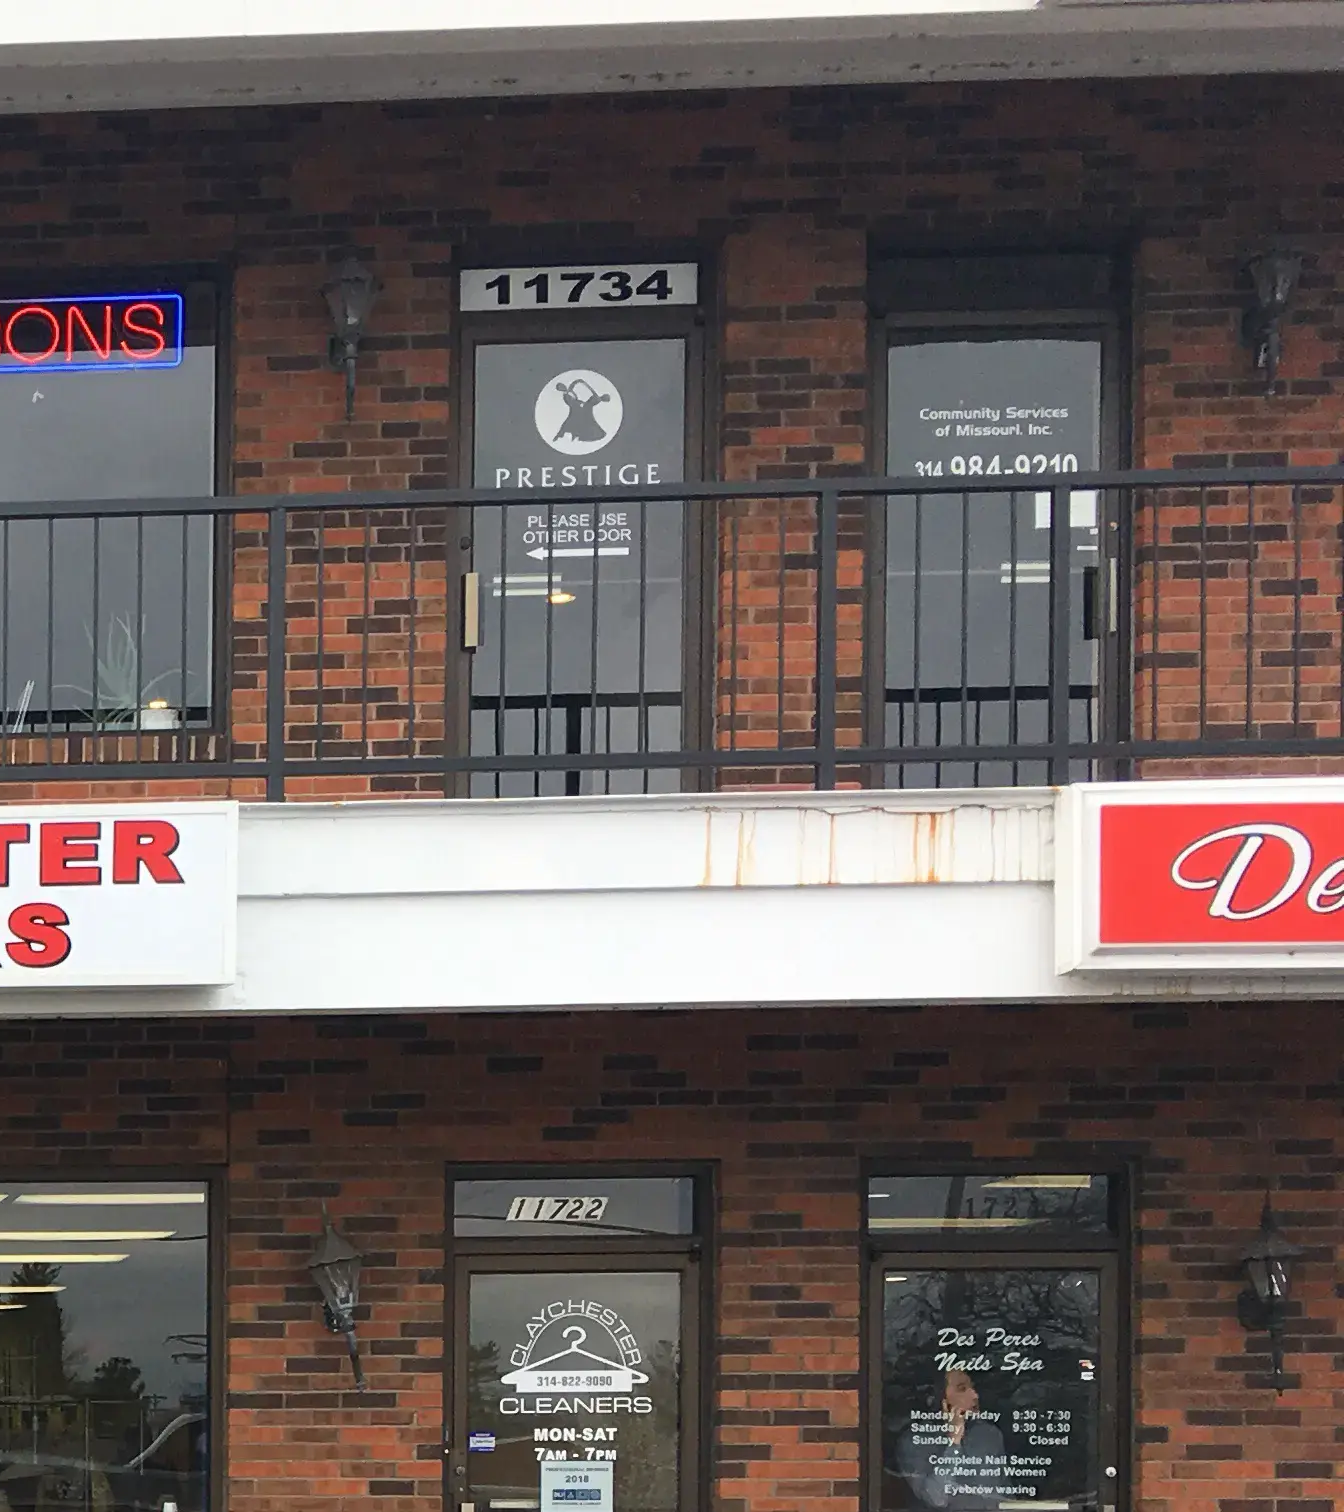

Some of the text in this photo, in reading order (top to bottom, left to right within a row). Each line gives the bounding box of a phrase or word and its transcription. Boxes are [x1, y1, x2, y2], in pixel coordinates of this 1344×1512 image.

[486, 270, 673, 304] 11734
[919, 406, 1069, 422] Community Services
[935, 424, 951, 437] of
[1028, 423, 1052, 436] Inc.
[495, 464, 661, 488] PRESTIGE
[914, 461, 944, 476] 314
[515, 1199, 604, 1220] 11722
[510, 1300, 642, 1367] CLAYCHESTER
[937, 1327, 1042, 1347] Des Peres
[934, 1352, 1045, 1376] Nails Spa
[499, 1397, 653, 1415] CLEANERS
[910, 1410, 955, 1423] Monday
[965, 1410, 1001, 1423] Friday
[1047, 1411, 1071, 1421] 7:30
[533, 1427, 618, 1442] MON-SAT
[910, 1423, 960, 1435] Saturday
[1012, 1423, 1037, 1433] 9:30
[1046, 1423, 1071, 1433] 6:30
[912, 1436, 1069, 1448] Sunday Closed
[533, 1447, 567, 1461] 7AM
[584, 1447, 617, 1461] 7PM
[928, 1455, 1052, 1467] Complete Nail Service
[564, 1475, 590, 1483] 2018
[934, 1467, 1047, 1477] for Men and Women
[944, 1484, 1037, 1497] Eyebrow waxing
